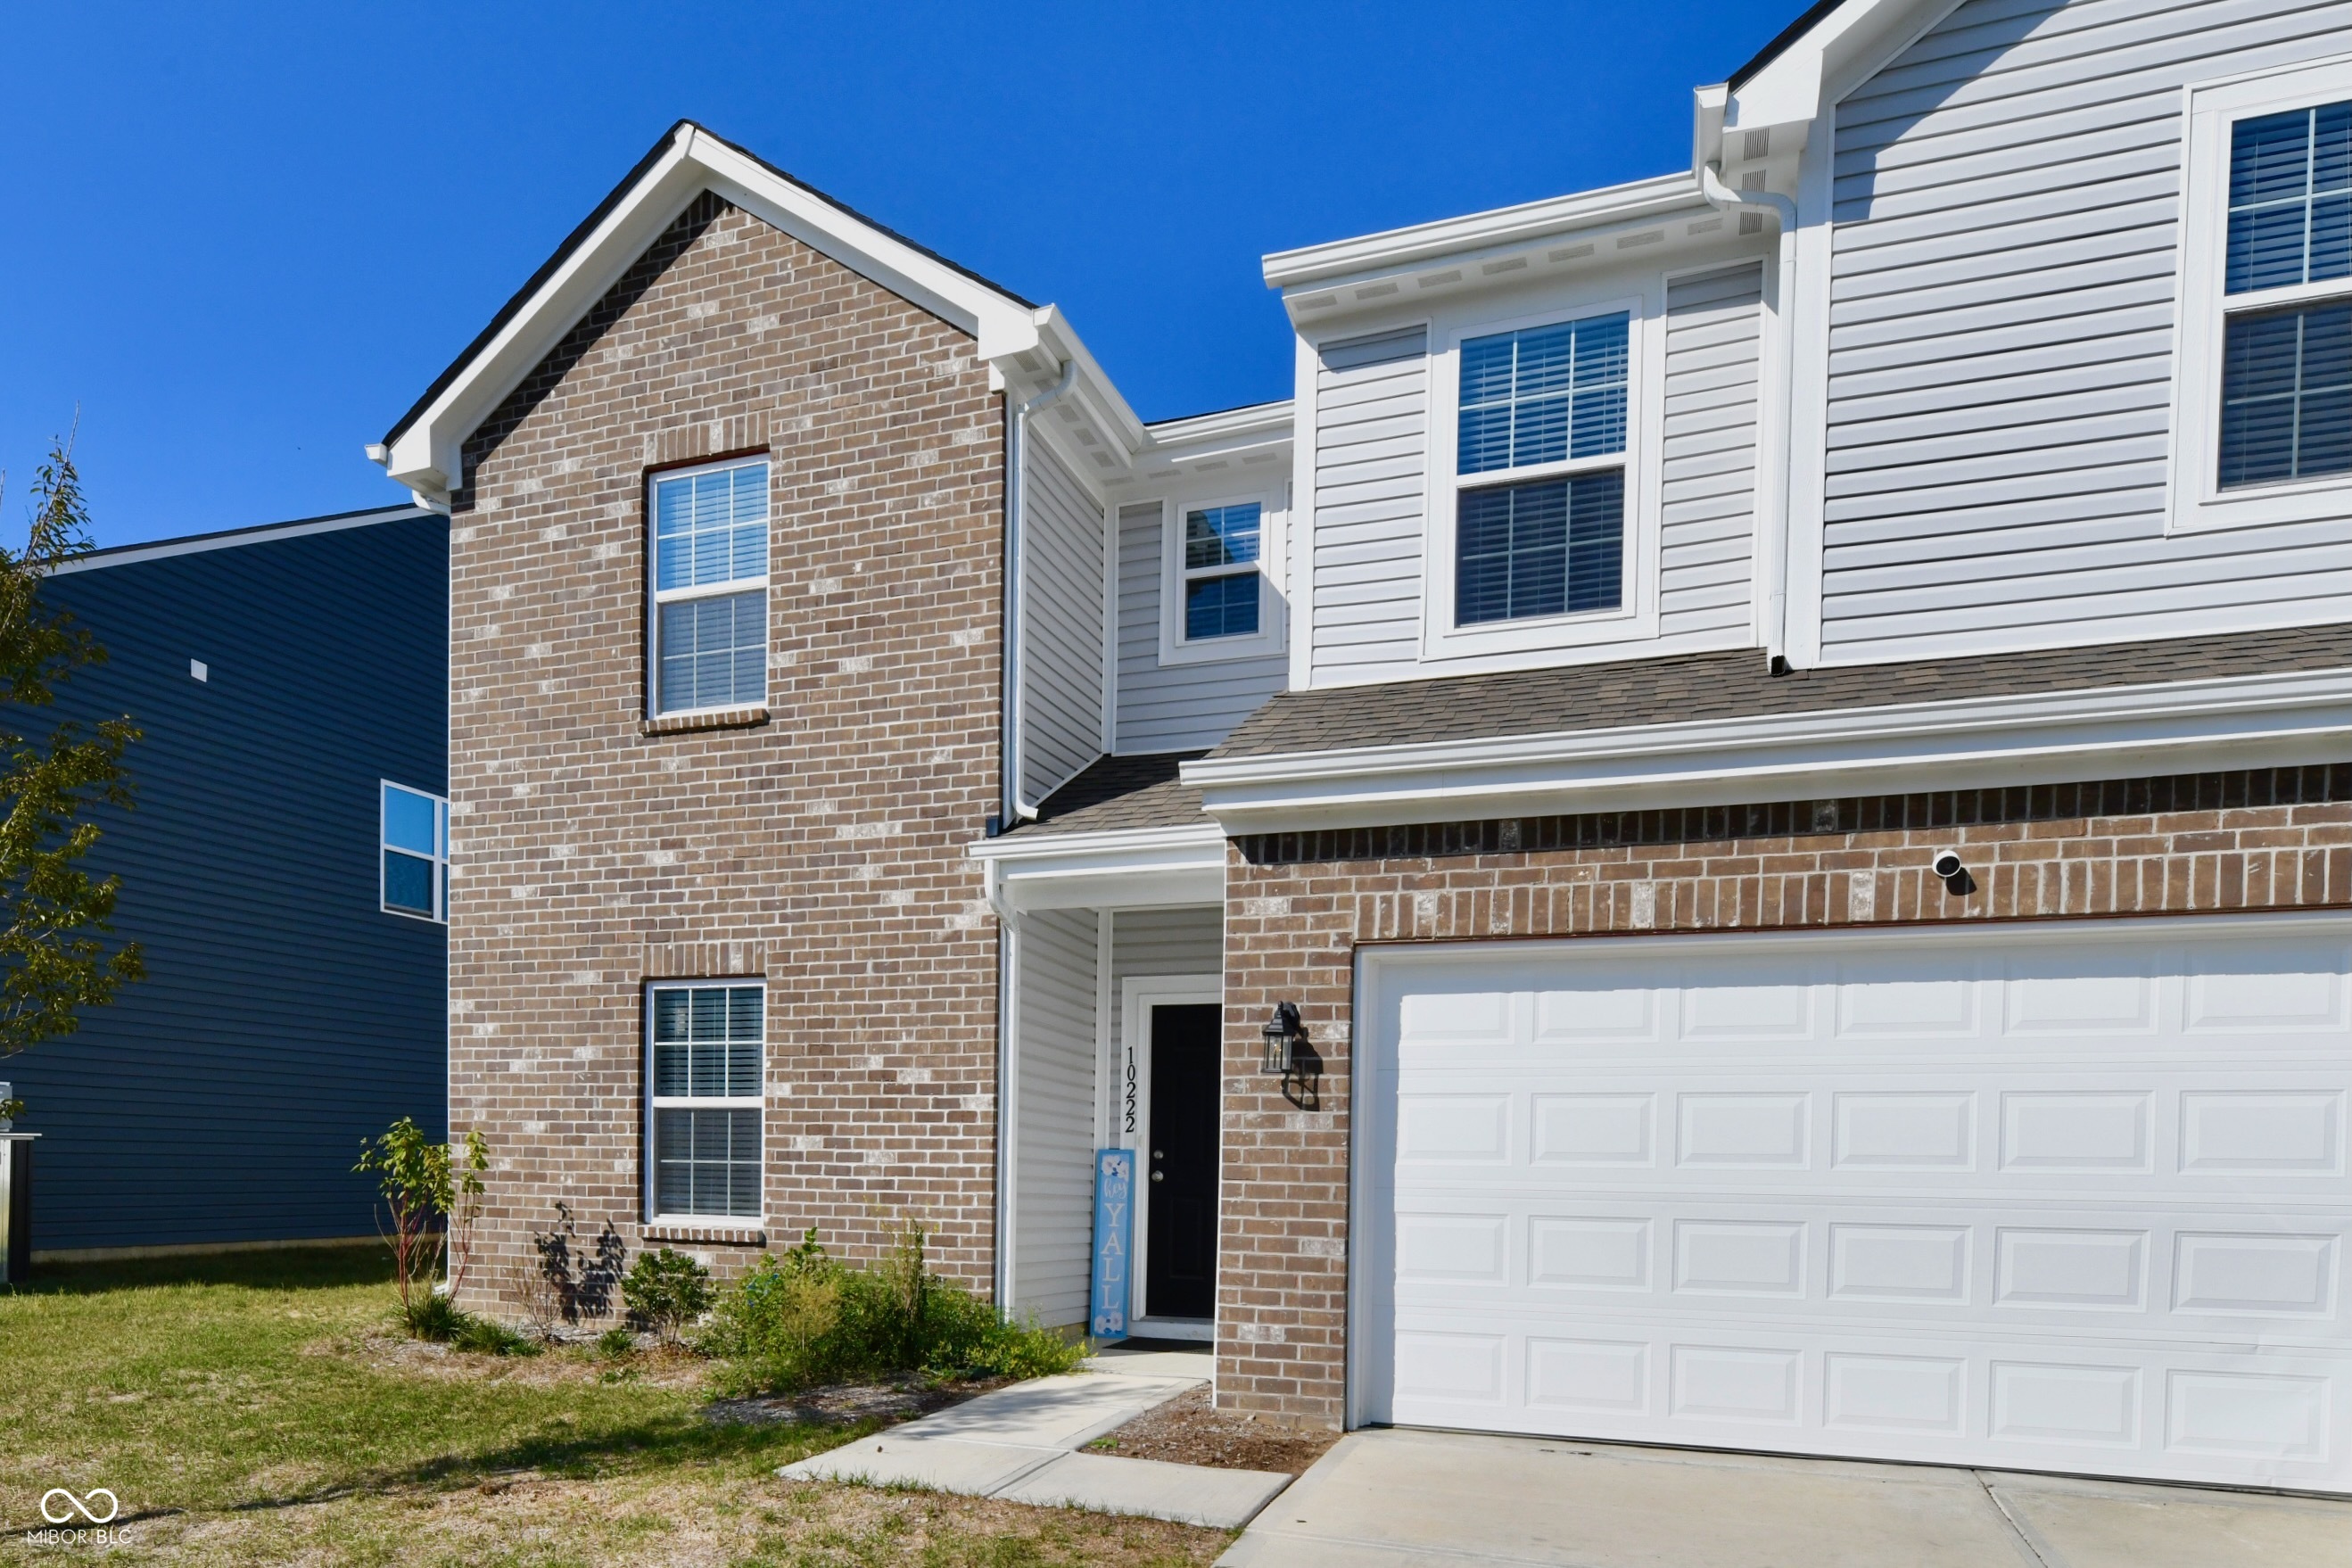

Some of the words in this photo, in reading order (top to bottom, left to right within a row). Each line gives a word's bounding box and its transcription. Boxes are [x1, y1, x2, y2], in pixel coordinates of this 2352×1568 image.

[1125, 1046, 1136, 1133] 10222
[1103, 1177, 1127, 1200] hey
[1100, 1202, 1126, 1309] YALL
